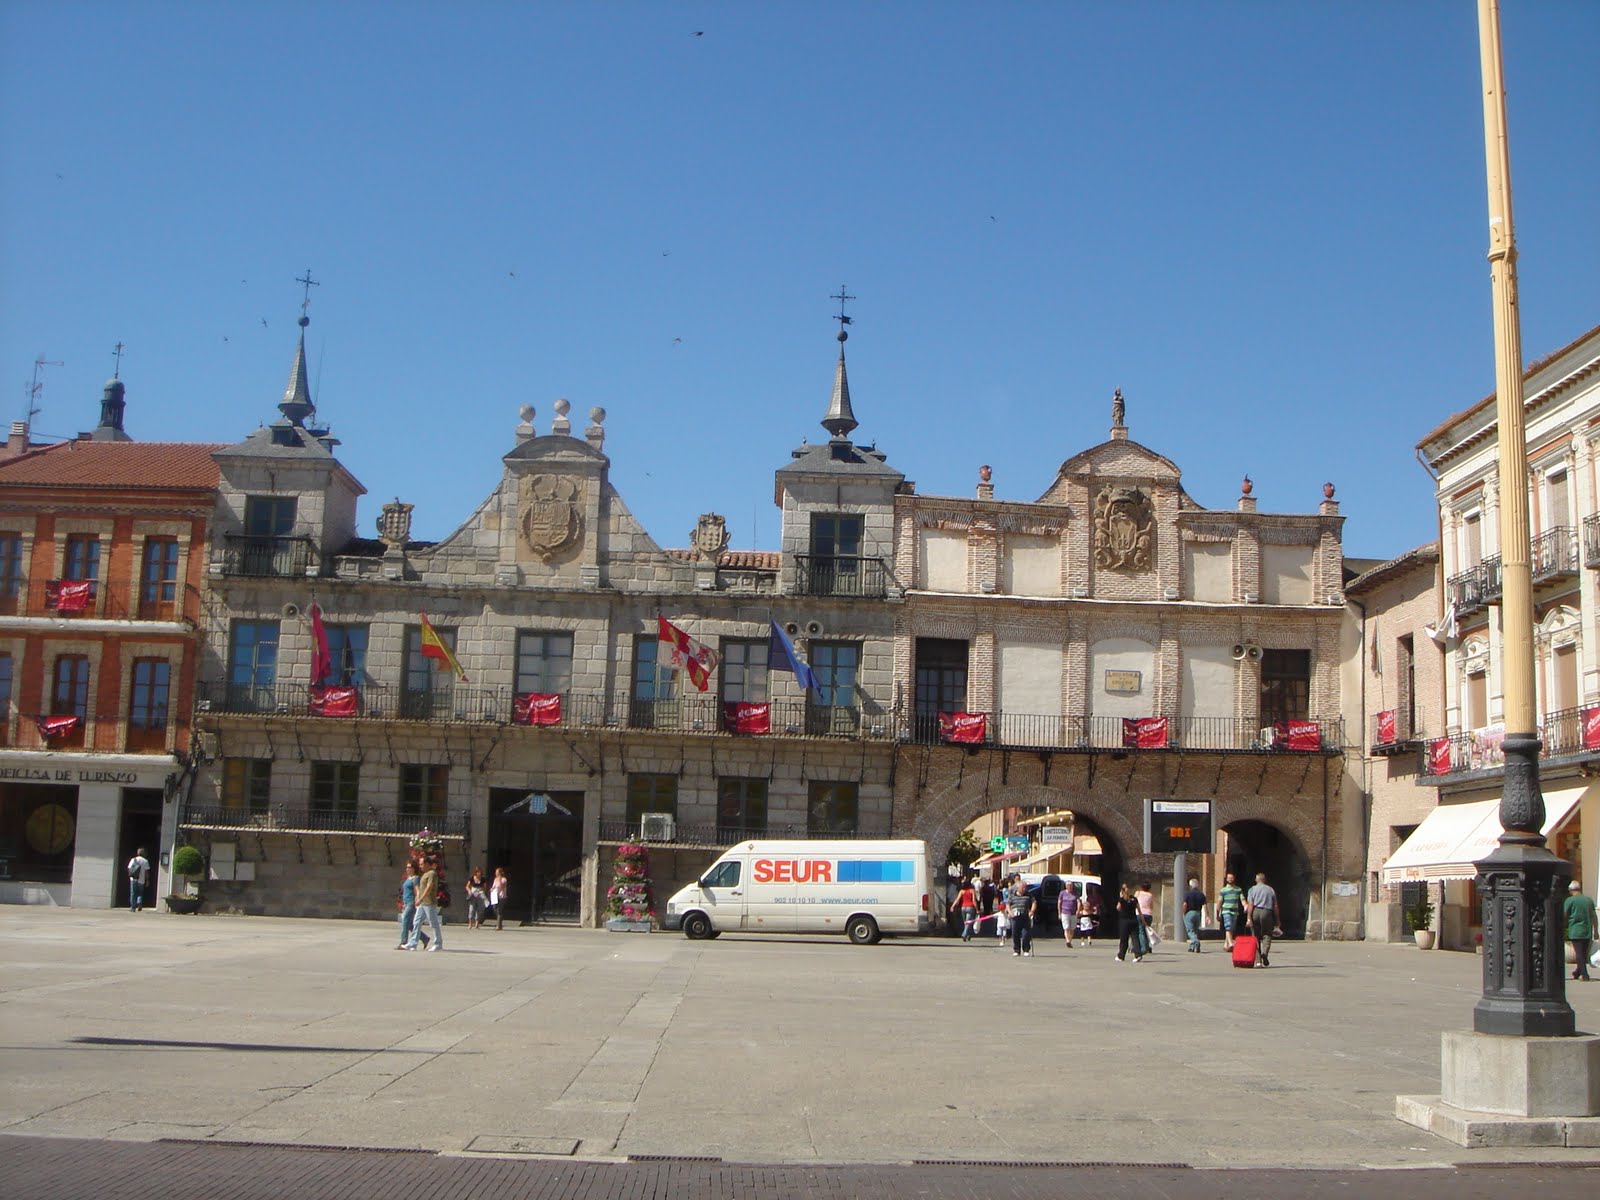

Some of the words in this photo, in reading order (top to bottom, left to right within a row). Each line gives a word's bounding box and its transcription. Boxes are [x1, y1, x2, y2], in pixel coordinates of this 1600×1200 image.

[55, 770, 72, 781] DE
[79, 770, 137, 783] TURISMO
[754, 859, 831, 883] SEUR
